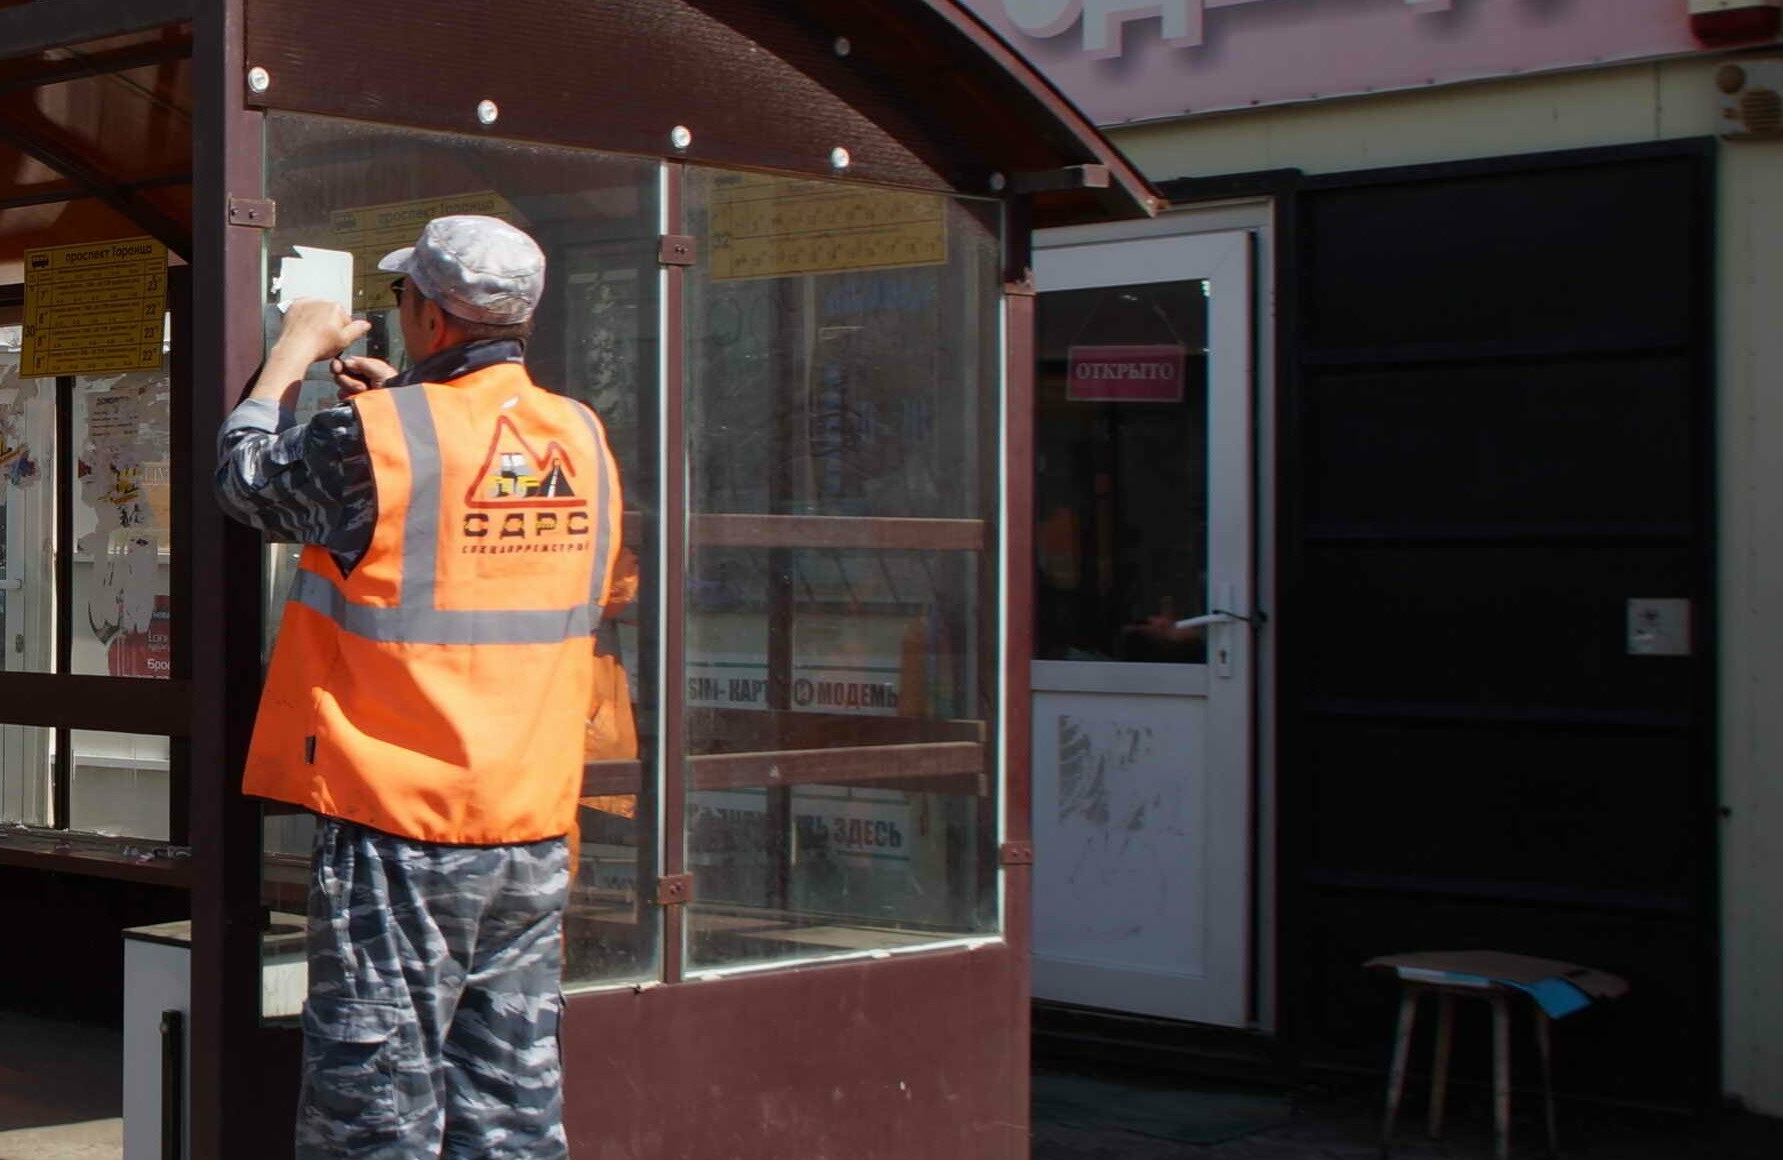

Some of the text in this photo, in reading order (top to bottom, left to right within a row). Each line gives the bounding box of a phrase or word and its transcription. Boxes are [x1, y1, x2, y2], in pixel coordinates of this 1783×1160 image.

[65, 244, 153, 263] проспект Таранца
[1075, 362, 1175, 381] ОТКРЫТО
[463, 512, 589, 540] СДРС
[728, 678, 770, 703] КАРТ
[833, 817, 903, 848] ЗДЕСЬ
